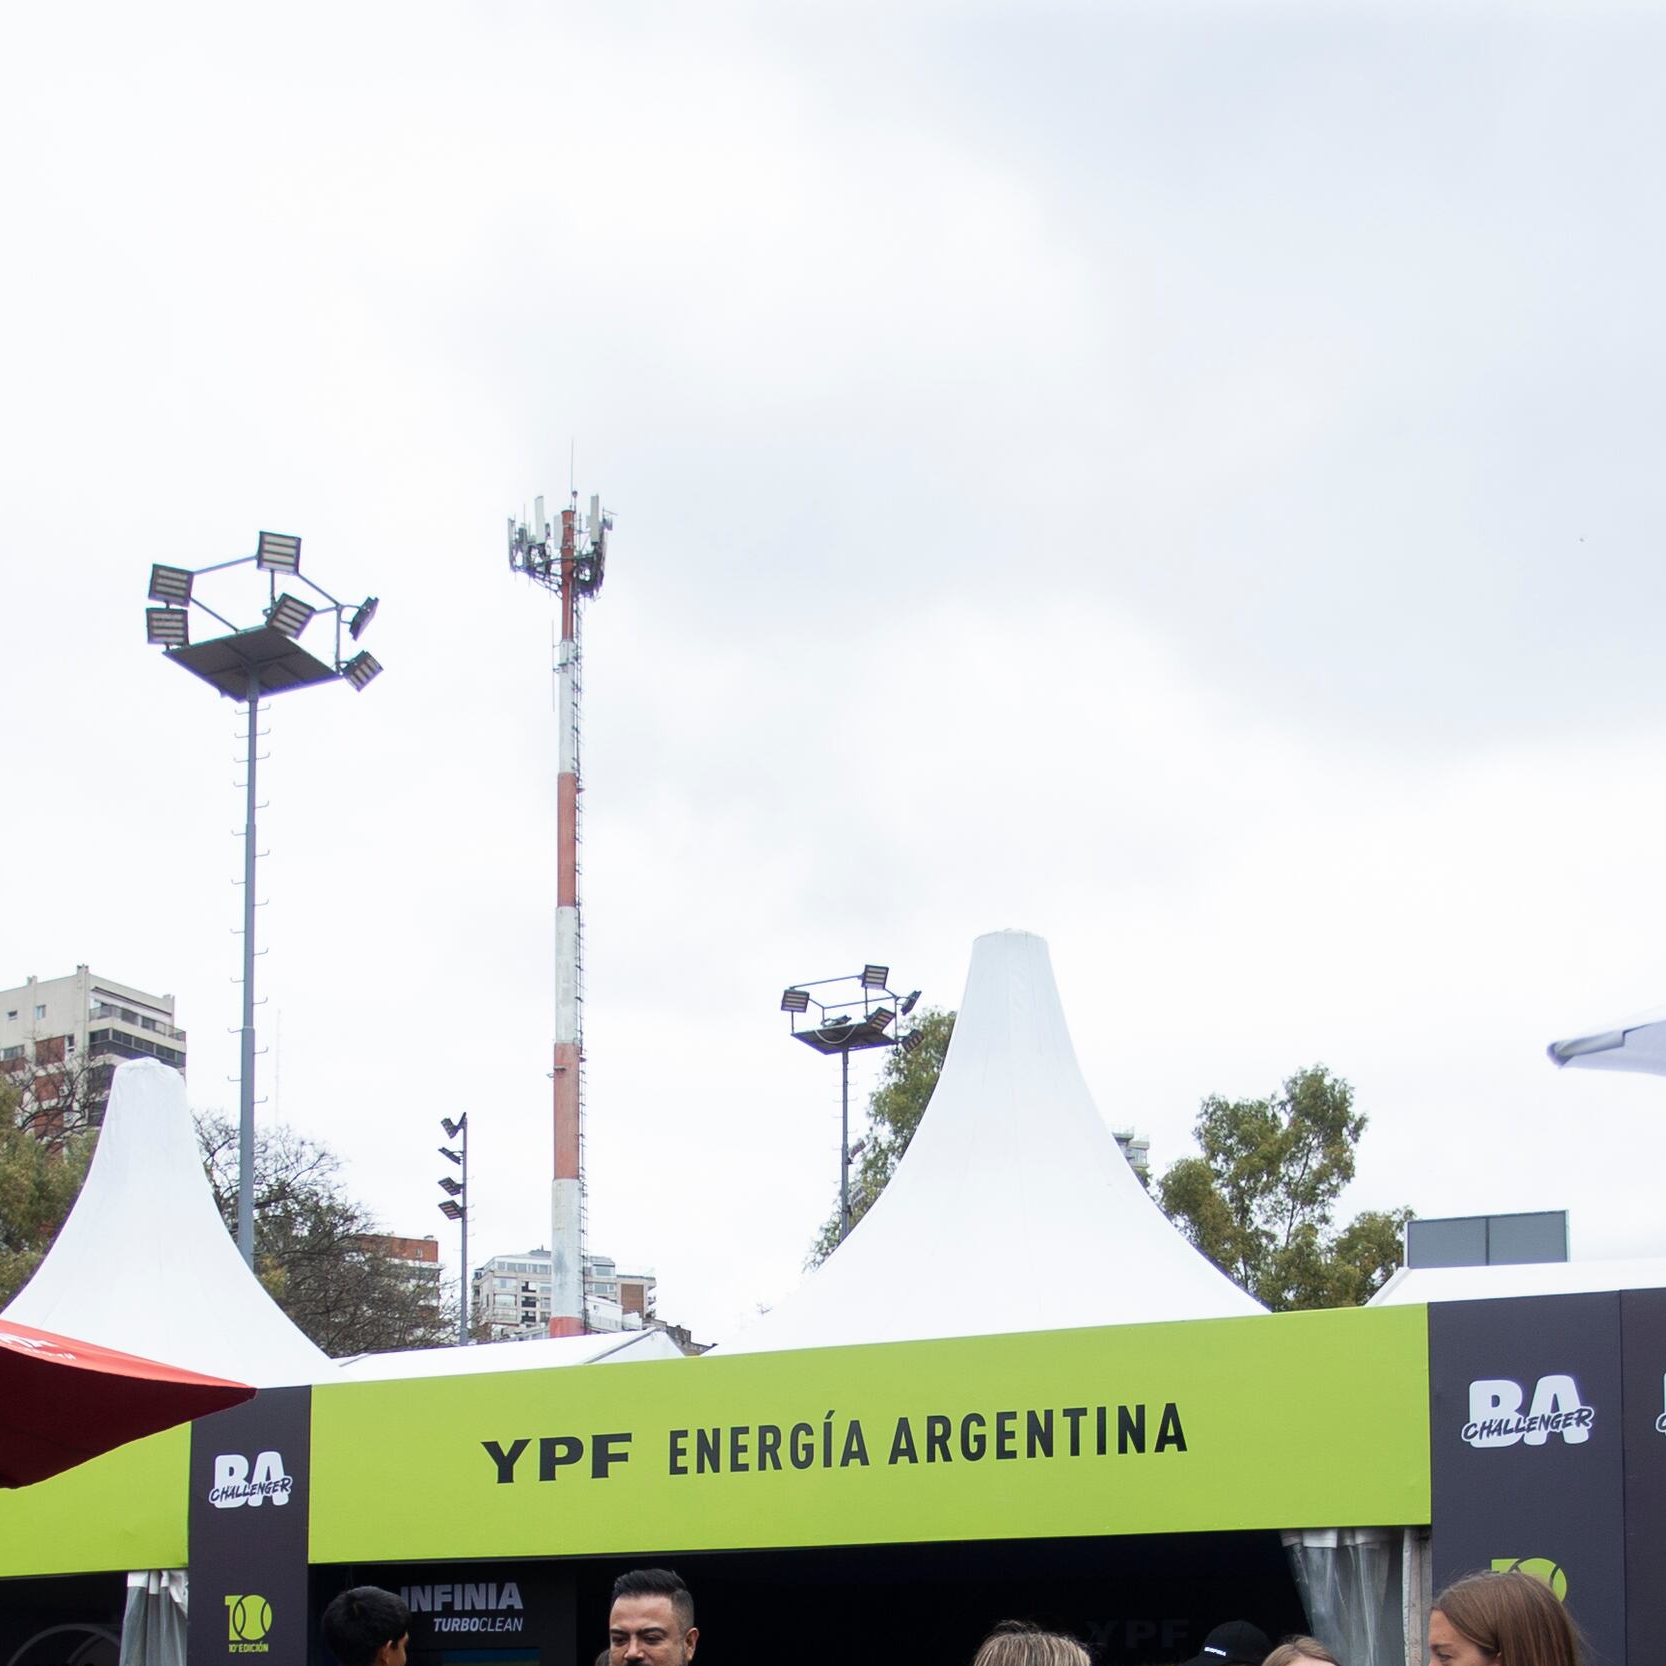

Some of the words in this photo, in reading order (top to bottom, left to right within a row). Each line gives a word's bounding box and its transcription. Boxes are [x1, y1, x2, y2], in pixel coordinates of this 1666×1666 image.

[1462, 1408, 1593, 1441] CHALLENGER
[1469, 1375, 1588, 1448] BA
[481, 1432, 633, 1485] YPF
[669, 1410, 870, 1475] ENERGÍA
[888, 1402, 1188, 1465] ARGENTINA
[209, 1477, 292, 1503] CHALLENGER
[214, 1451, 289, 1508] BA
[401, 1582, 523, 1612] INFINIA
[434, 1617, 523, 1632] TURBOCLEAN
